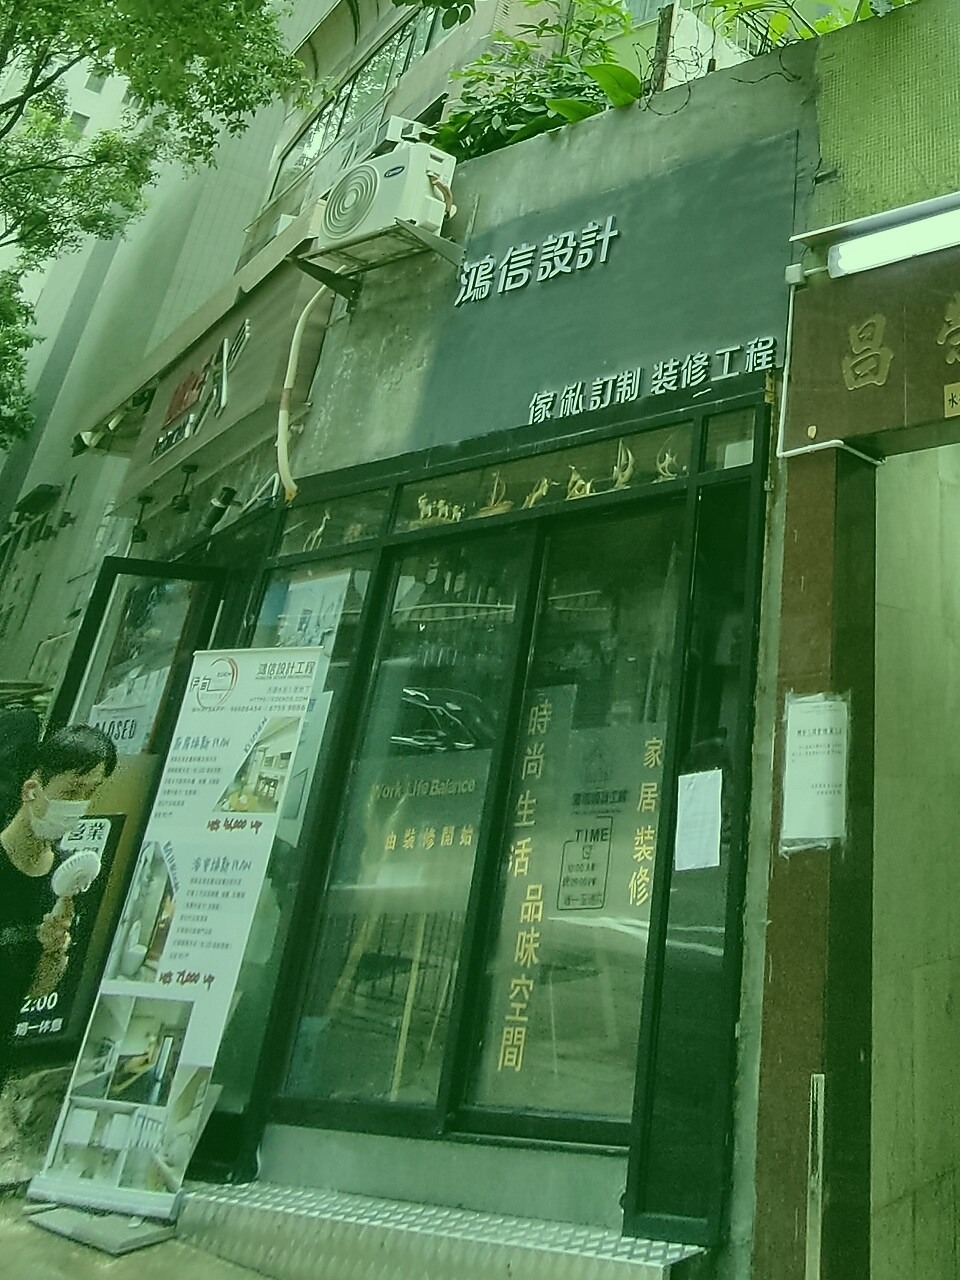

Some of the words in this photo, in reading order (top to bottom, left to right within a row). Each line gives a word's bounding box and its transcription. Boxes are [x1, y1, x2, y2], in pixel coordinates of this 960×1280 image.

[454, 214, 620, 307] 鴻信設計
[575, 827, 609, 843] TIME
[628, 736, 663, 907] 家居裝修
